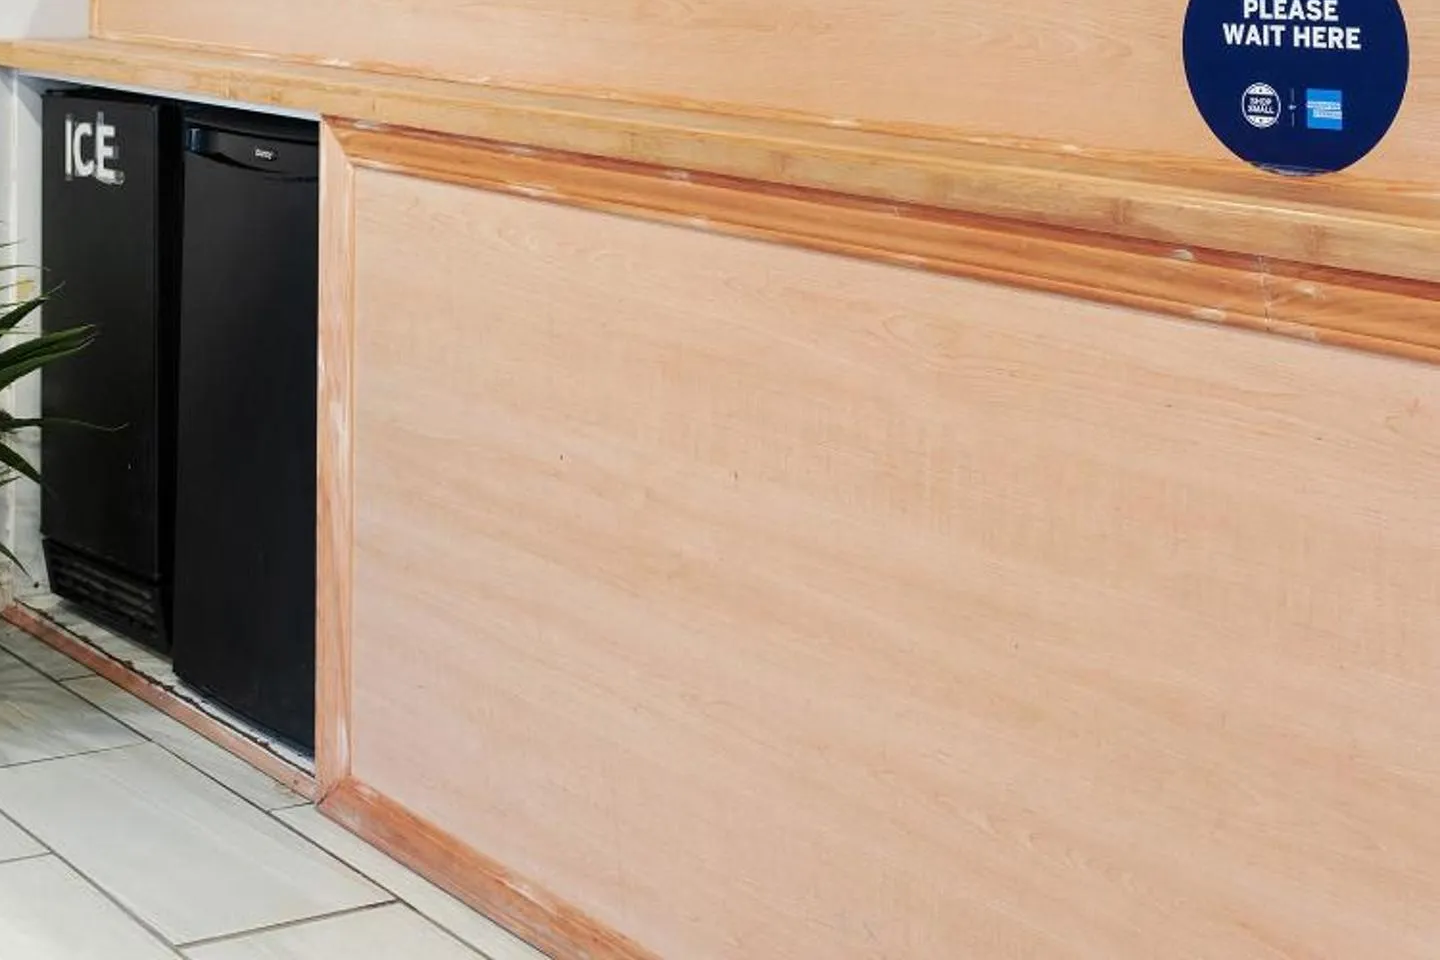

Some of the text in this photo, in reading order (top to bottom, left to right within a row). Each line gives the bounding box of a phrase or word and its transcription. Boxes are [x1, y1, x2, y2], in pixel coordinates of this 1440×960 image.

[1222, 22, 1362, 50] WAIT HERE
[1247, 105, 1276, 115] SMALL
[65, 112, 123, 183] ICE
